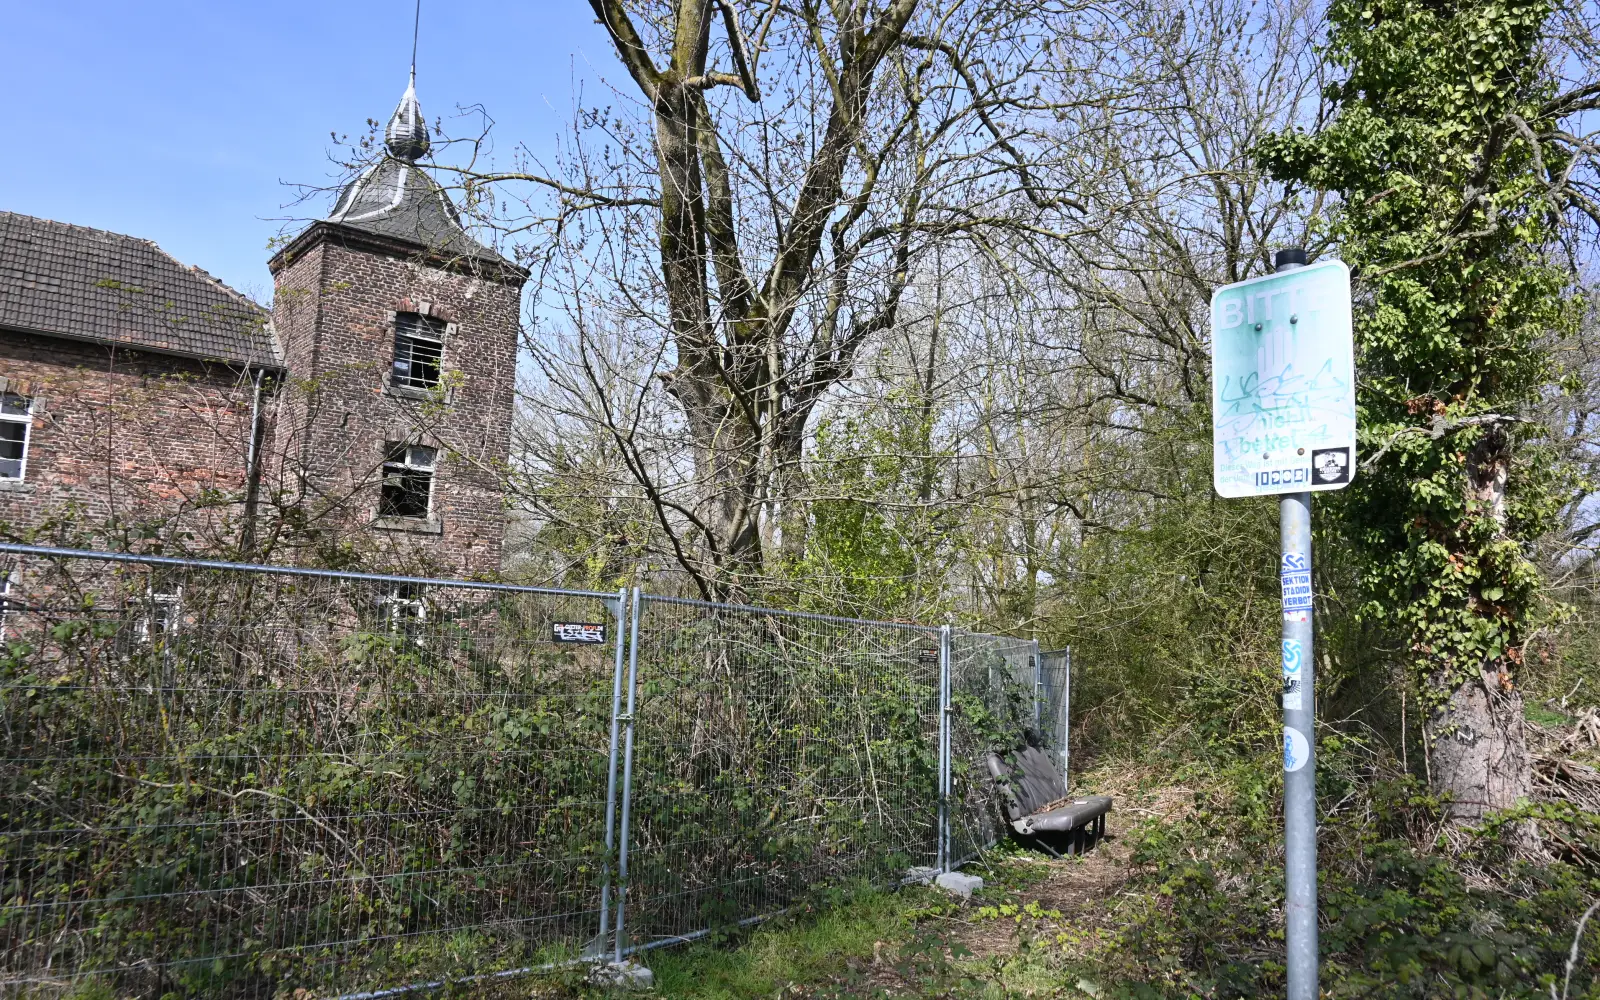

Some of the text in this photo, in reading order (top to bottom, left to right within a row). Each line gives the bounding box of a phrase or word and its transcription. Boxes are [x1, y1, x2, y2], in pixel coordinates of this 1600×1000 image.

[1282, 575, 1310, 586] SEKTION
[1283, 586, 1310, 596] STADION
[1283, 596, 1311, 606] VERBOT
